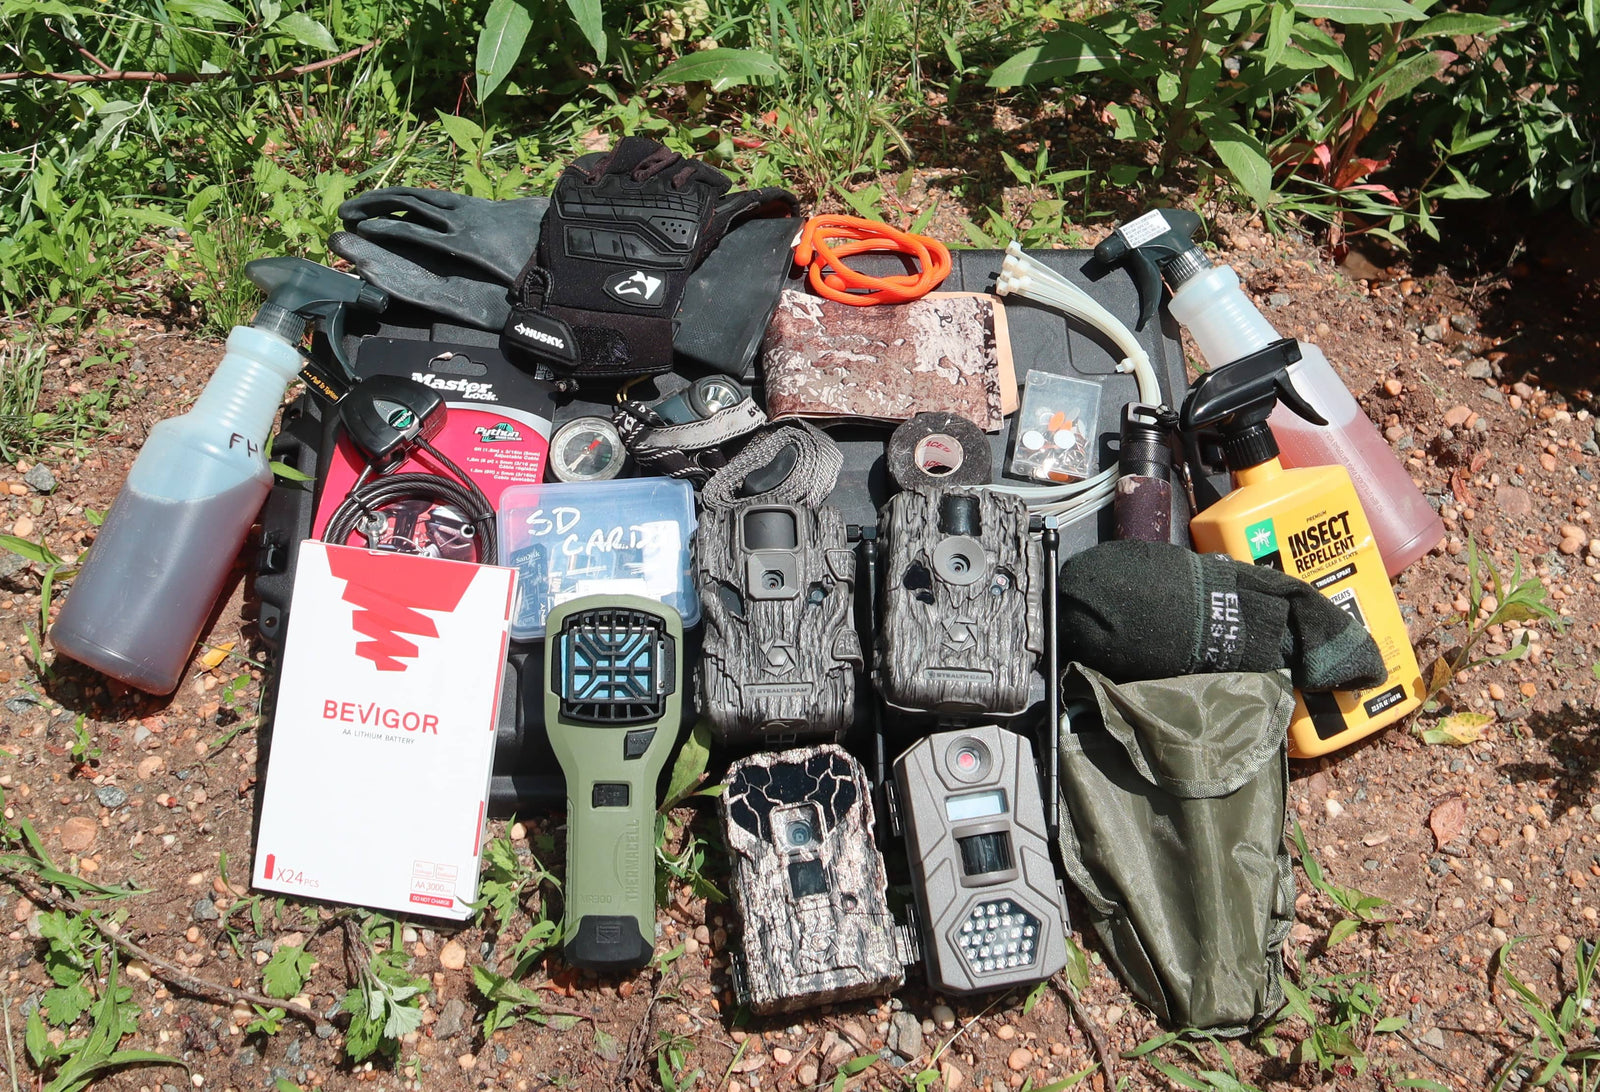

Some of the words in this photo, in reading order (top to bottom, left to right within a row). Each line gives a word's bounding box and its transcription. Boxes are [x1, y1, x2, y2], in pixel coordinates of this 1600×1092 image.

[524, 327, 563, 348] HUSKY
[411, 372, 493, 394] Master
[474, 426, 520, 438] Python
[526, 506, 581, 537] SD
[1306, 510, 1327, 523] PREMIUM
[1288, 510, 1351, 560] INSECT
[1294, 534, 1356, 574] REPELLENT
[1316, 575, 1336, 588] TRIGGER
[1336, 568, 1352, 579] SPRAY
[1211, 592, 1225, 621] UK
[1225, 593, 1240, 622] EU
[322, 700, 439, 735] BEVIGOR
[342, 728, 352, 736] AA
[354, 730, 382, 740] LITHIUM
[384, 734, 416, 744] BATTERY
[624, 818, 640, 902] THERMACELL
